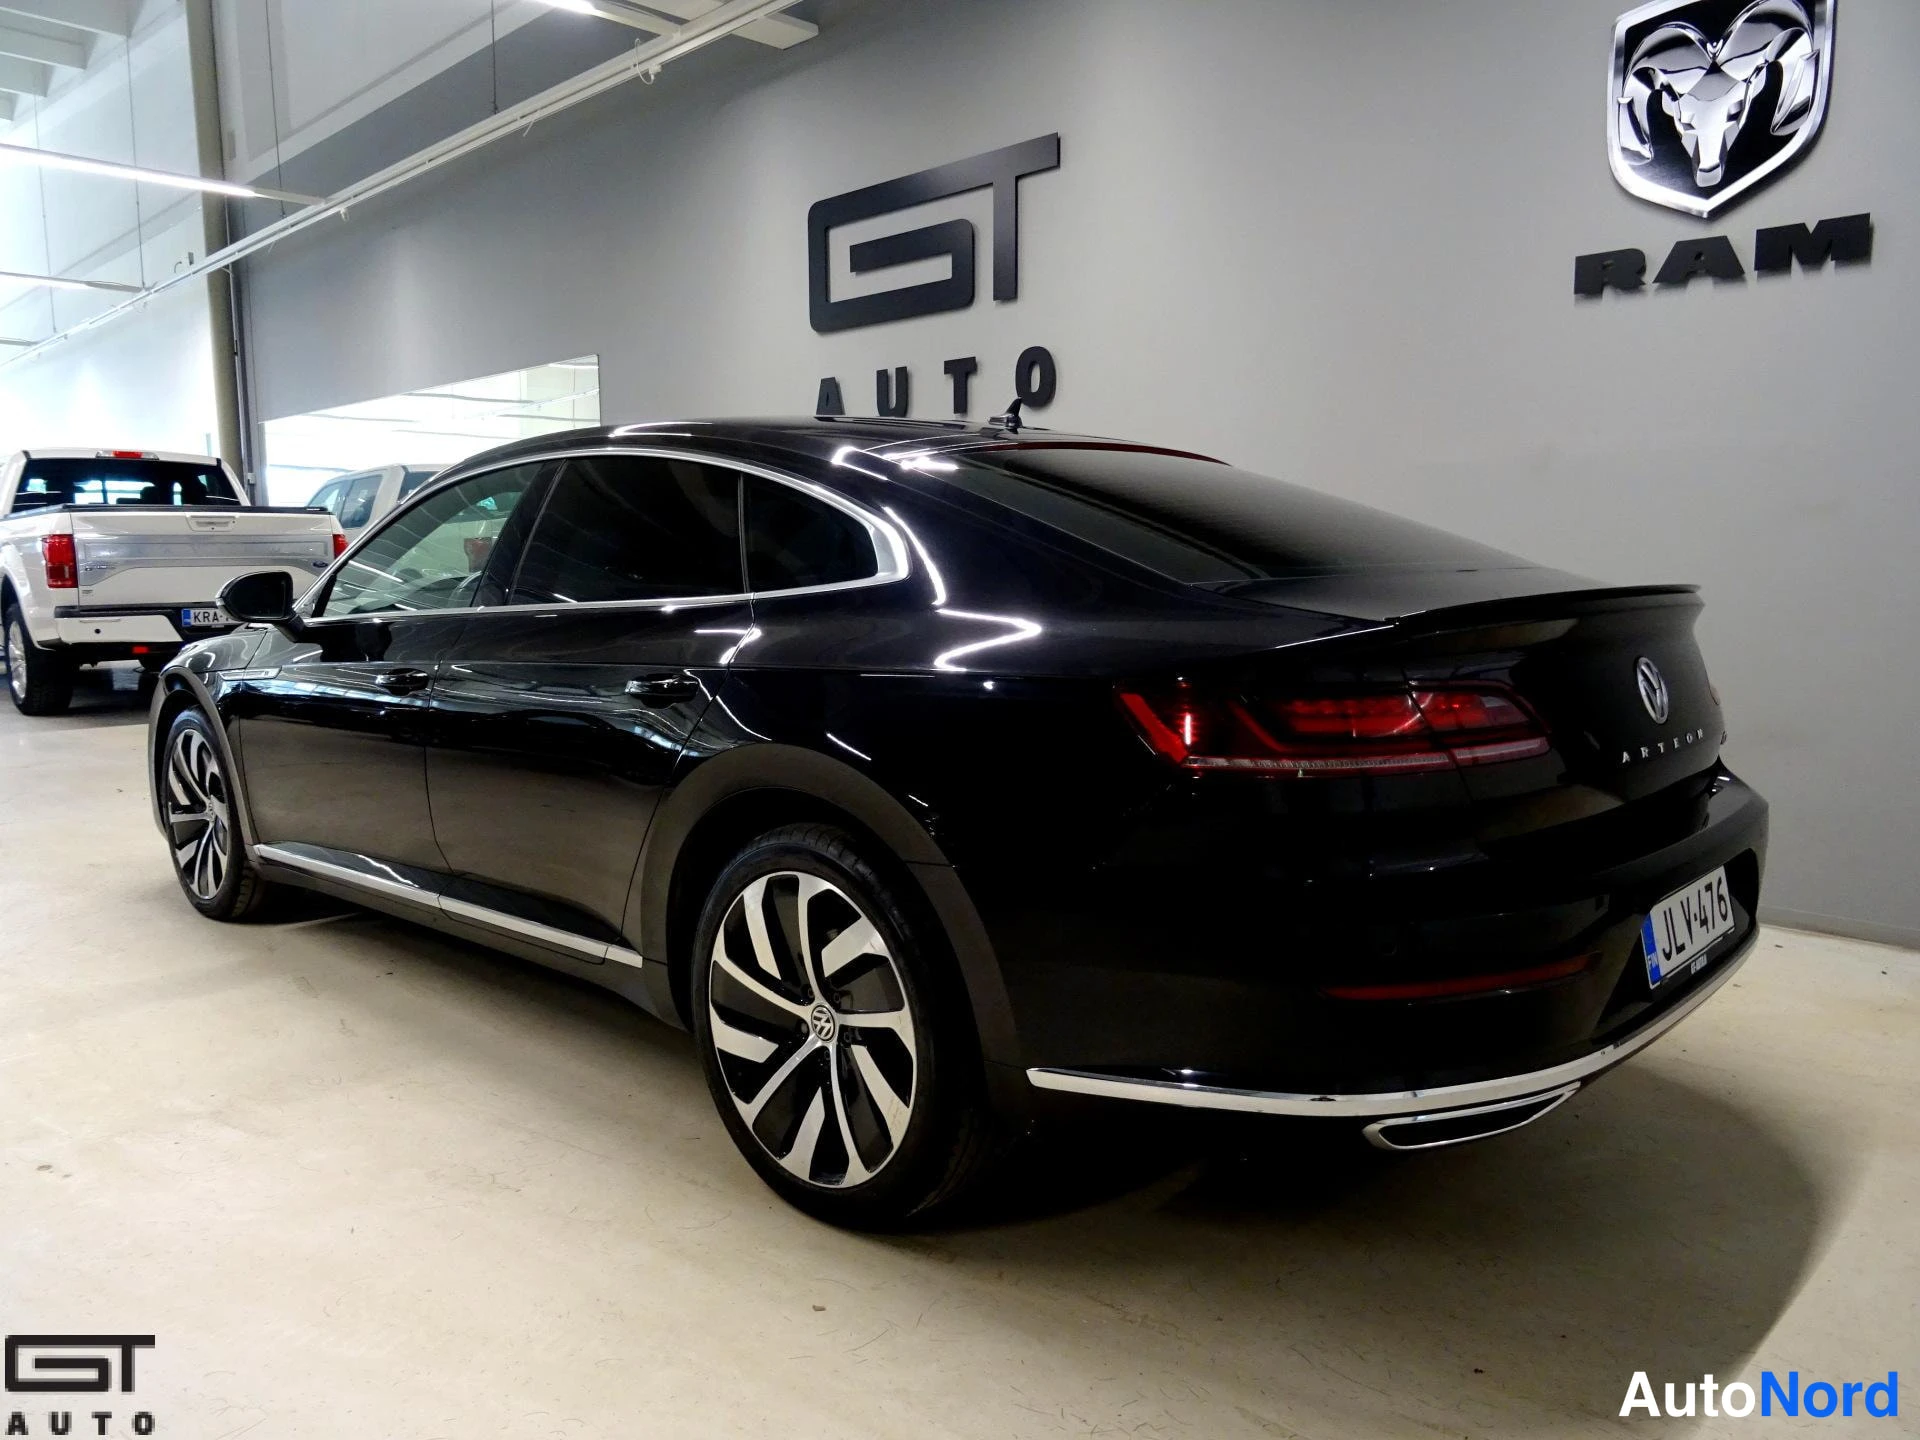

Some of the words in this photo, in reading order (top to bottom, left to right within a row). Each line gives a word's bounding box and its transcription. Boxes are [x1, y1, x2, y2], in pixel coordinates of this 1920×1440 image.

[808, 133, 1060, 333] GT
[1574, 213, 1872, 295] RAM
[816, 346, 1056, 417] AUTO
[193, 610, 229, 623] KRA-
[1622, 728, 1704, 764] ARTEON
[1662, 876, 1728, 962] JLV-476
